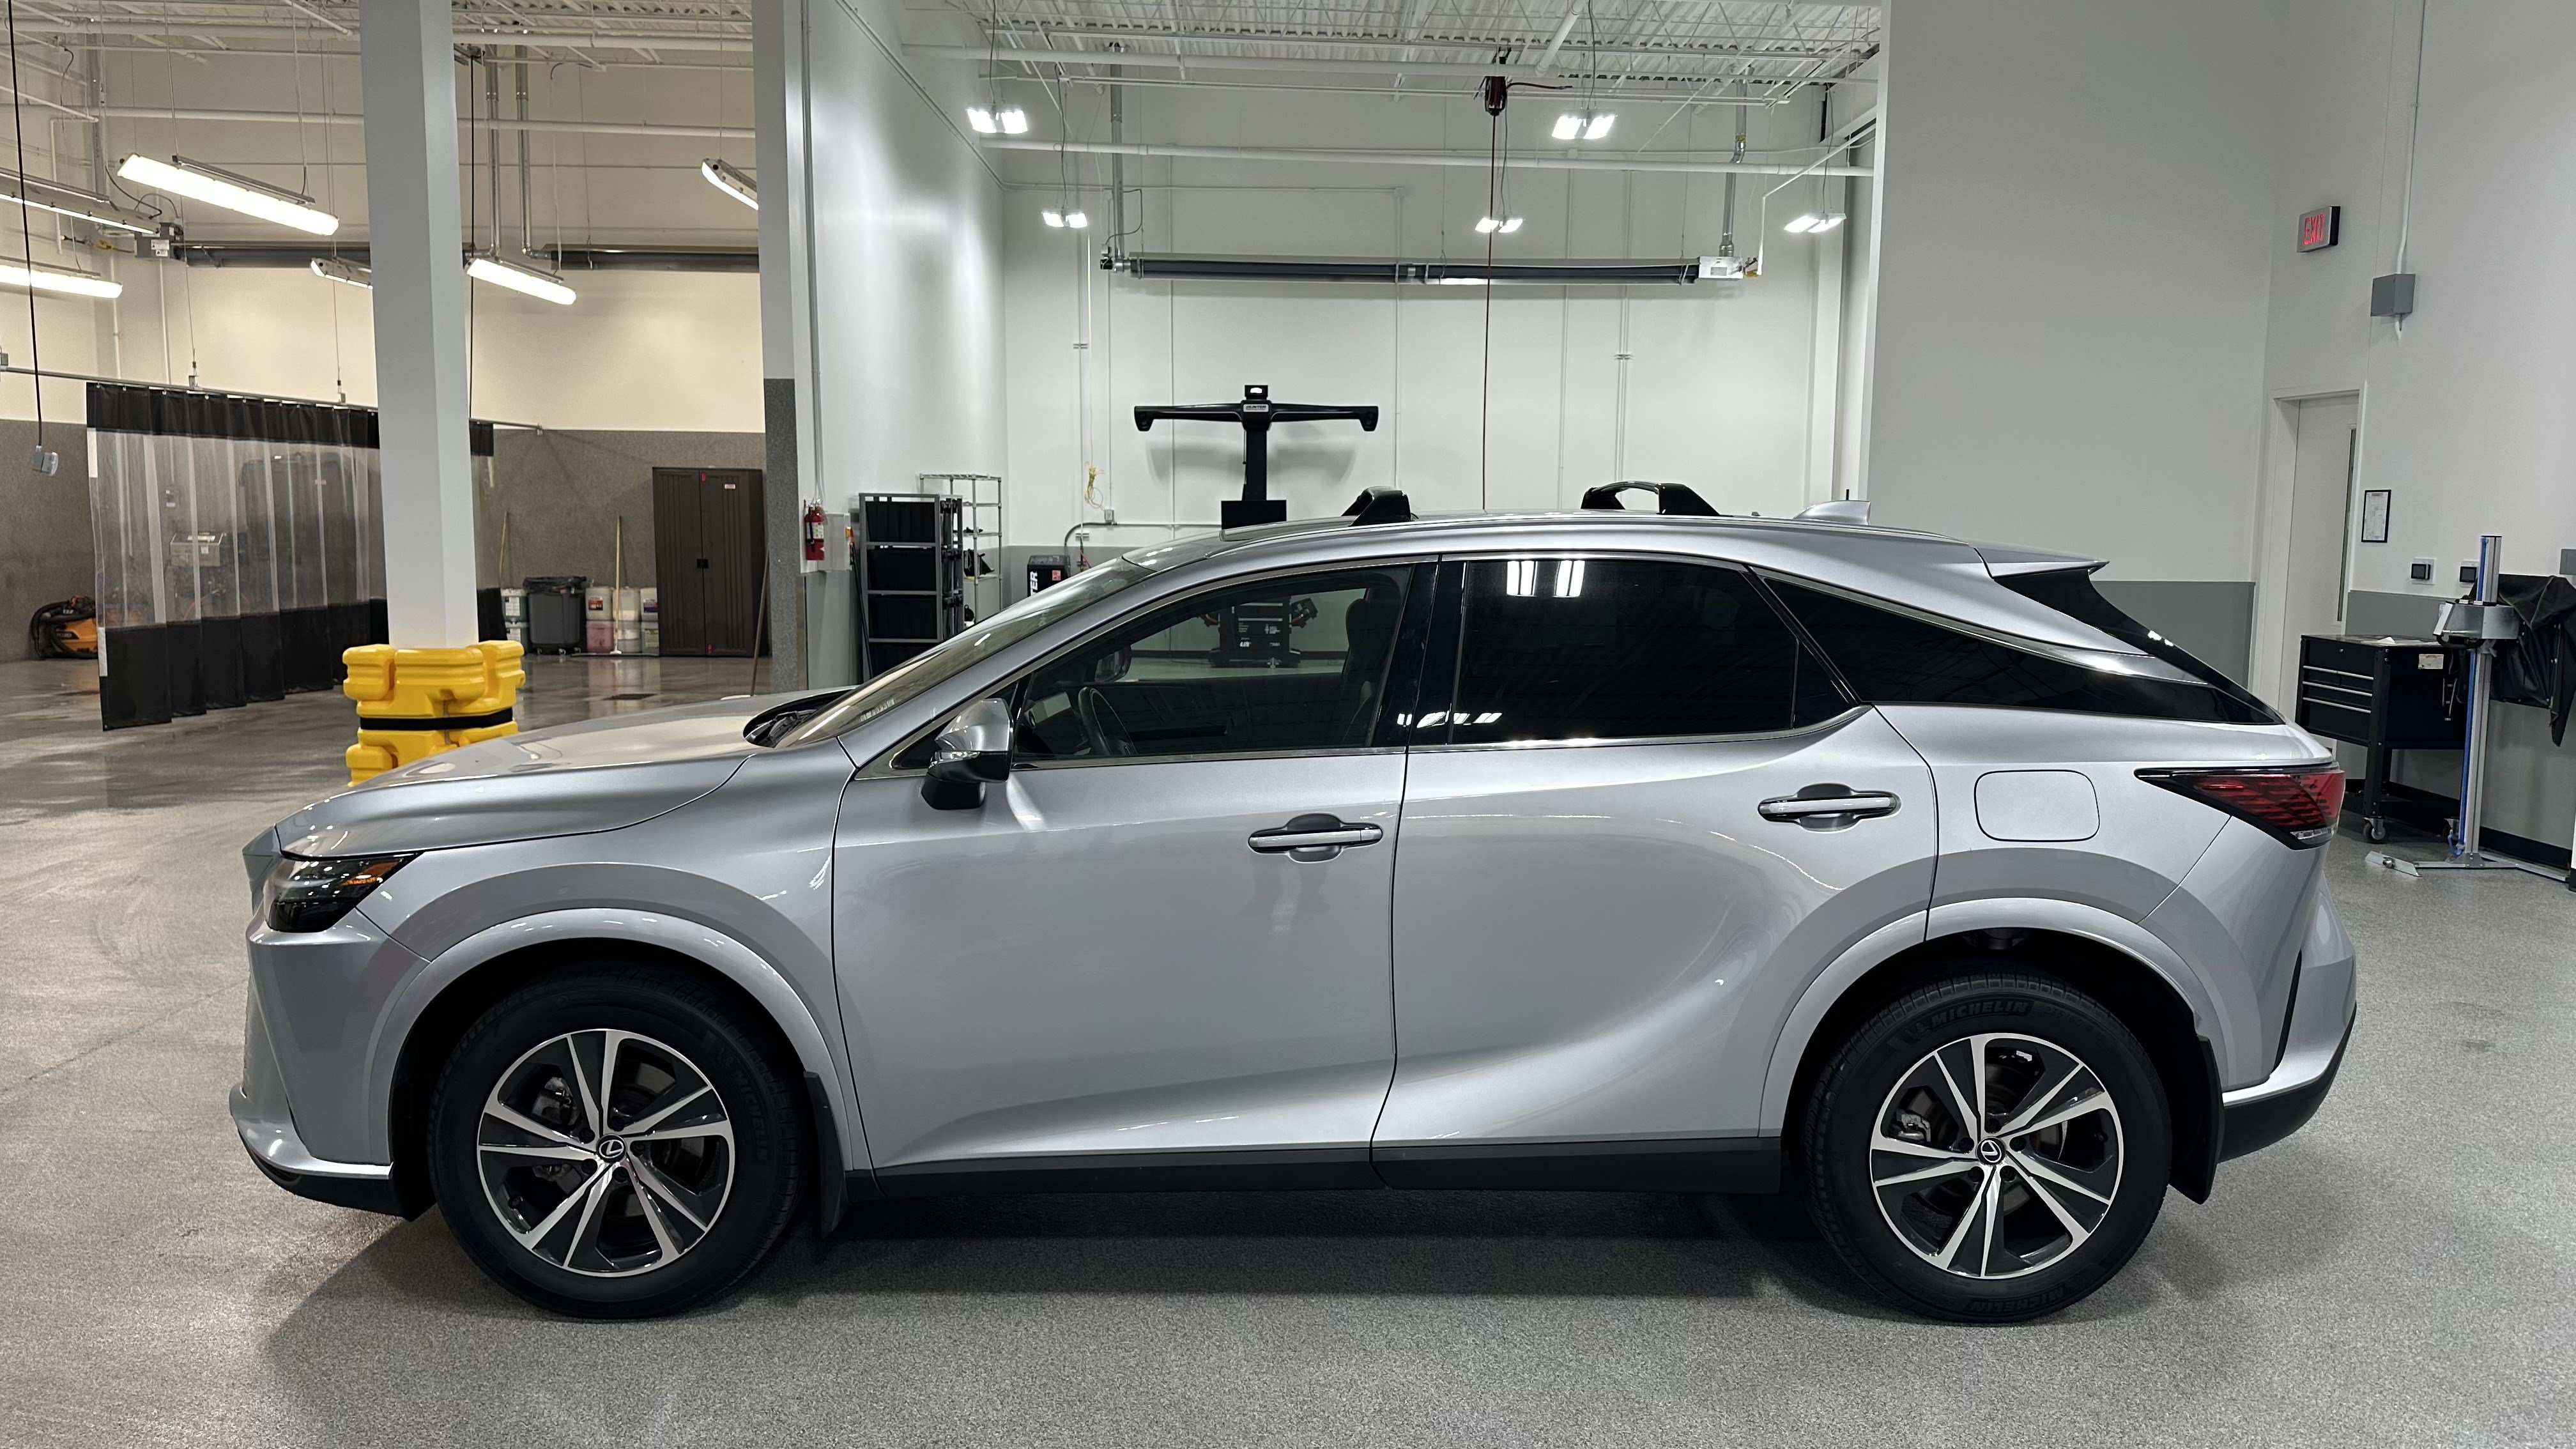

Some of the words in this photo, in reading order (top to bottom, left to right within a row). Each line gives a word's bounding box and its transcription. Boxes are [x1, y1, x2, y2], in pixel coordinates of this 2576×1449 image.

[2303, 213, 2325, 245] EXIT
[1931, 1000, 2029, 1028] MICHELIN
[1968, 1286, 2065, 1312] MICHELIN
